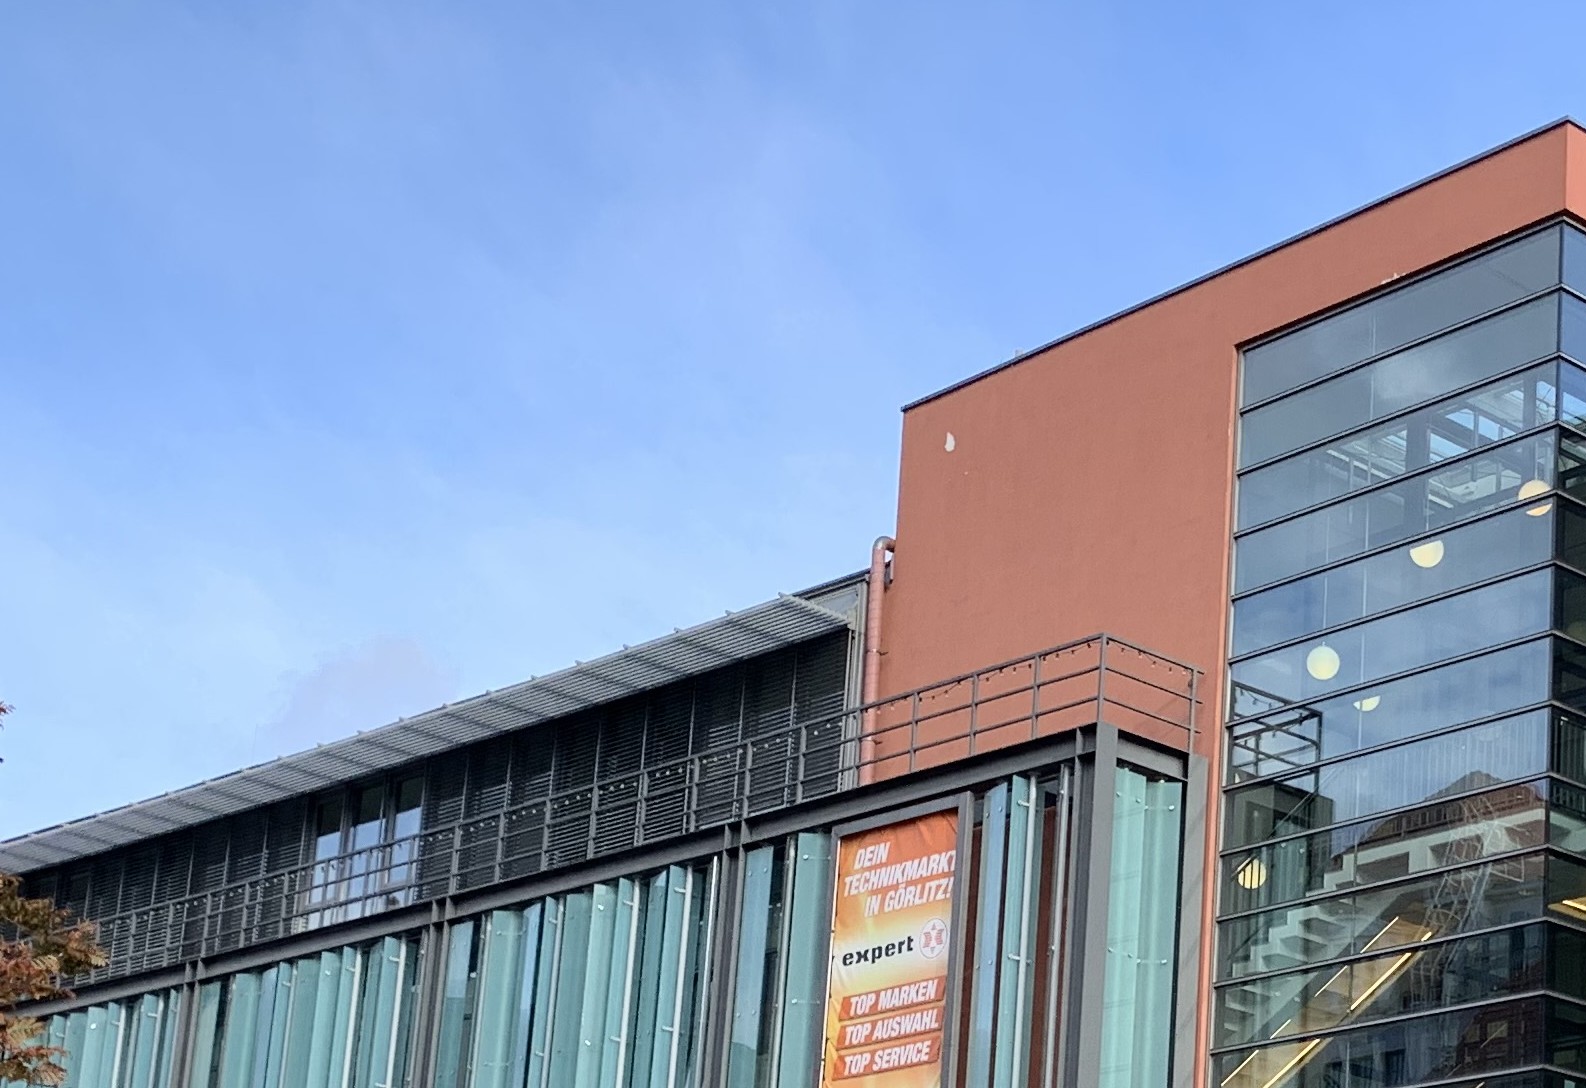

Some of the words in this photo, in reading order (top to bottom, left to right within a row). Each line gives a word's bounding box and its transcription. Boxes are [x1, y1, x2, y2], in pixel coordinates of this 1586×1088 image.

[843, 850, 957, 897] TECHNIKMARKT
[853, 842, 890, 870] DEIN
[864, 894, 882, 918] IN
[884, 876, 954, 912] GÖRLITZ!
[842, 935, 914, 967] expert
[849, 996, 877, 1017] TOP
[878, 979, 938, 1011] MARKEN
[844, 1023, 872, 1046] TOP
[872, 1009, 939, 1041] AUSWAHL
[843, 1053, 871, 1076] TOP
[872, 1040, 931, 1071] SERVICE
